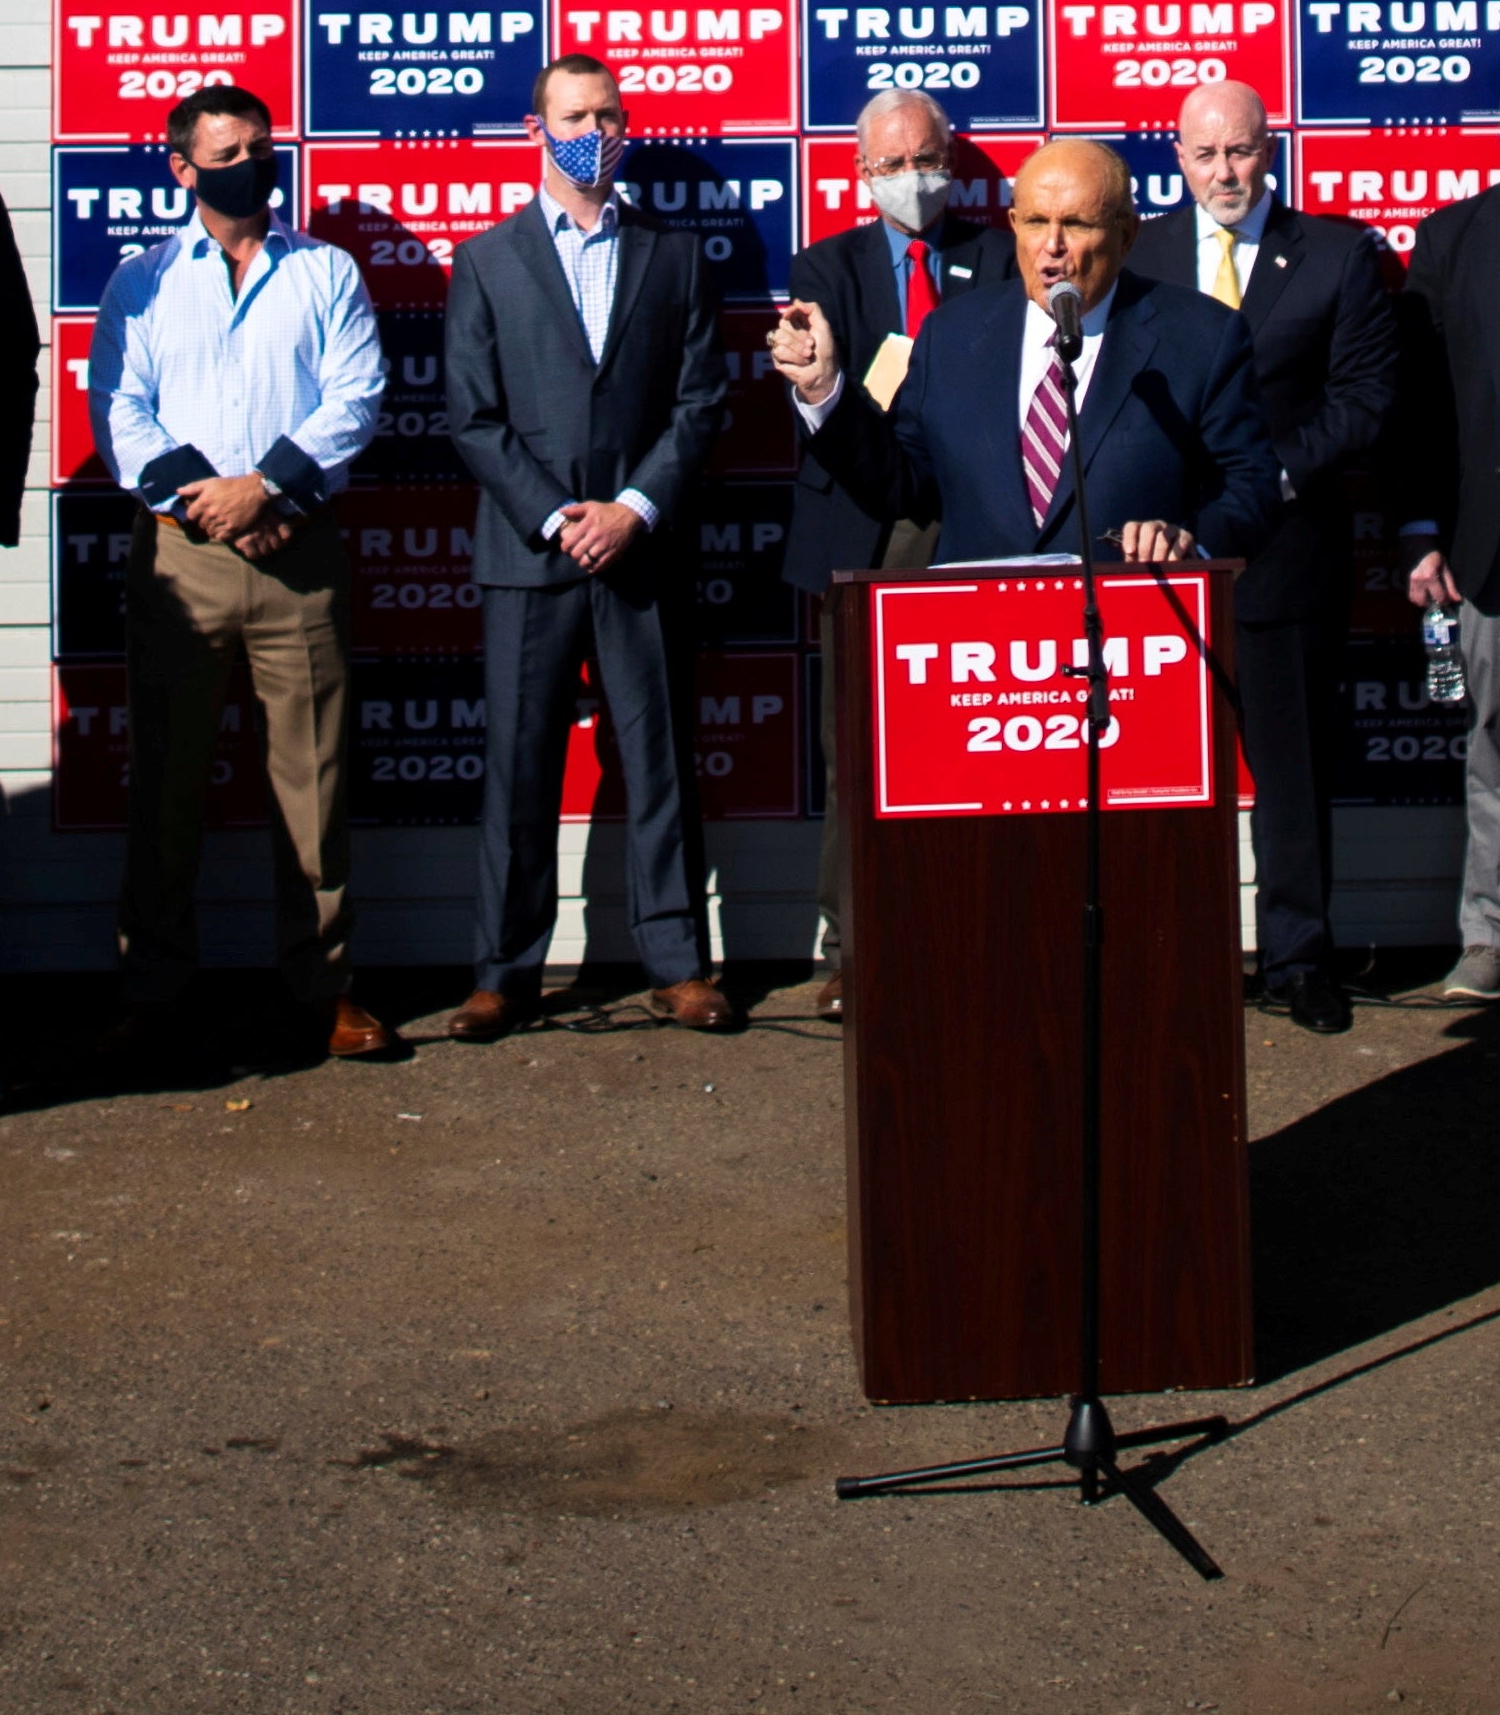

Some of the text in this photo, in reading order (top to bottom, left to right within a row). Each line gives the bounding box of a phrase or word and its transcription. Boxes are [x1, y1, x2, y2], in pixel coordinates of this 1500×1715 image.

[68, 15, 285, 47] TRUMP
[319, 13, 533, 44] TRUMP
[568, 9, 782, 42] TRUMP
[816, 7, 1029, 38] TRUMP
[1063, 3, 1275, 36] TRUMP
[358, 50, 494, 61] KEEP AMERICA GREAT!
[607, 47, 743, 59] KEEP AMERICA GREAT!
[856, 45, 990, 56] KEEP AMERICA GREAT!
[1103, 41, 1236, 53] KEEP AMERICA GREAT!
[1348, 38, 1481, 49] KEEP AMERICA GREAT!
[108, 52, 244, 64] KEEP AMERICA GREAT!
[1360, 56, 1470, 83] 2020
[370, 68, 483, 95] 2020
[619, 65, 732, 92] 2020
[868, 62, 980, 91] 2020
[1115, 58, 1226, 87] 2020
[68, 188, 284, 219] TRU
[318, 183, 533, 215] TRUMP
[613, 180, 784, 211] RUMP
[358, 221, 494, 232] KEEP AMERICA GREAT!
[1349, 208, 1380, 219] KEEP
[108, 226, 138, 236] KEEP
[370, 239, 453, 265] 202
[377, 412, 450, 437] 202
[370, 583, 483, 609] 2020
[896, 635, 1187, 685] TRUMP
[951, 688, 1134, 707] KEEP AMERICA GAT!
[360, 698, 486, 730] RUM
[966, 714, 1120, 752] 2020
[370, 754, 485, 782] 2020
